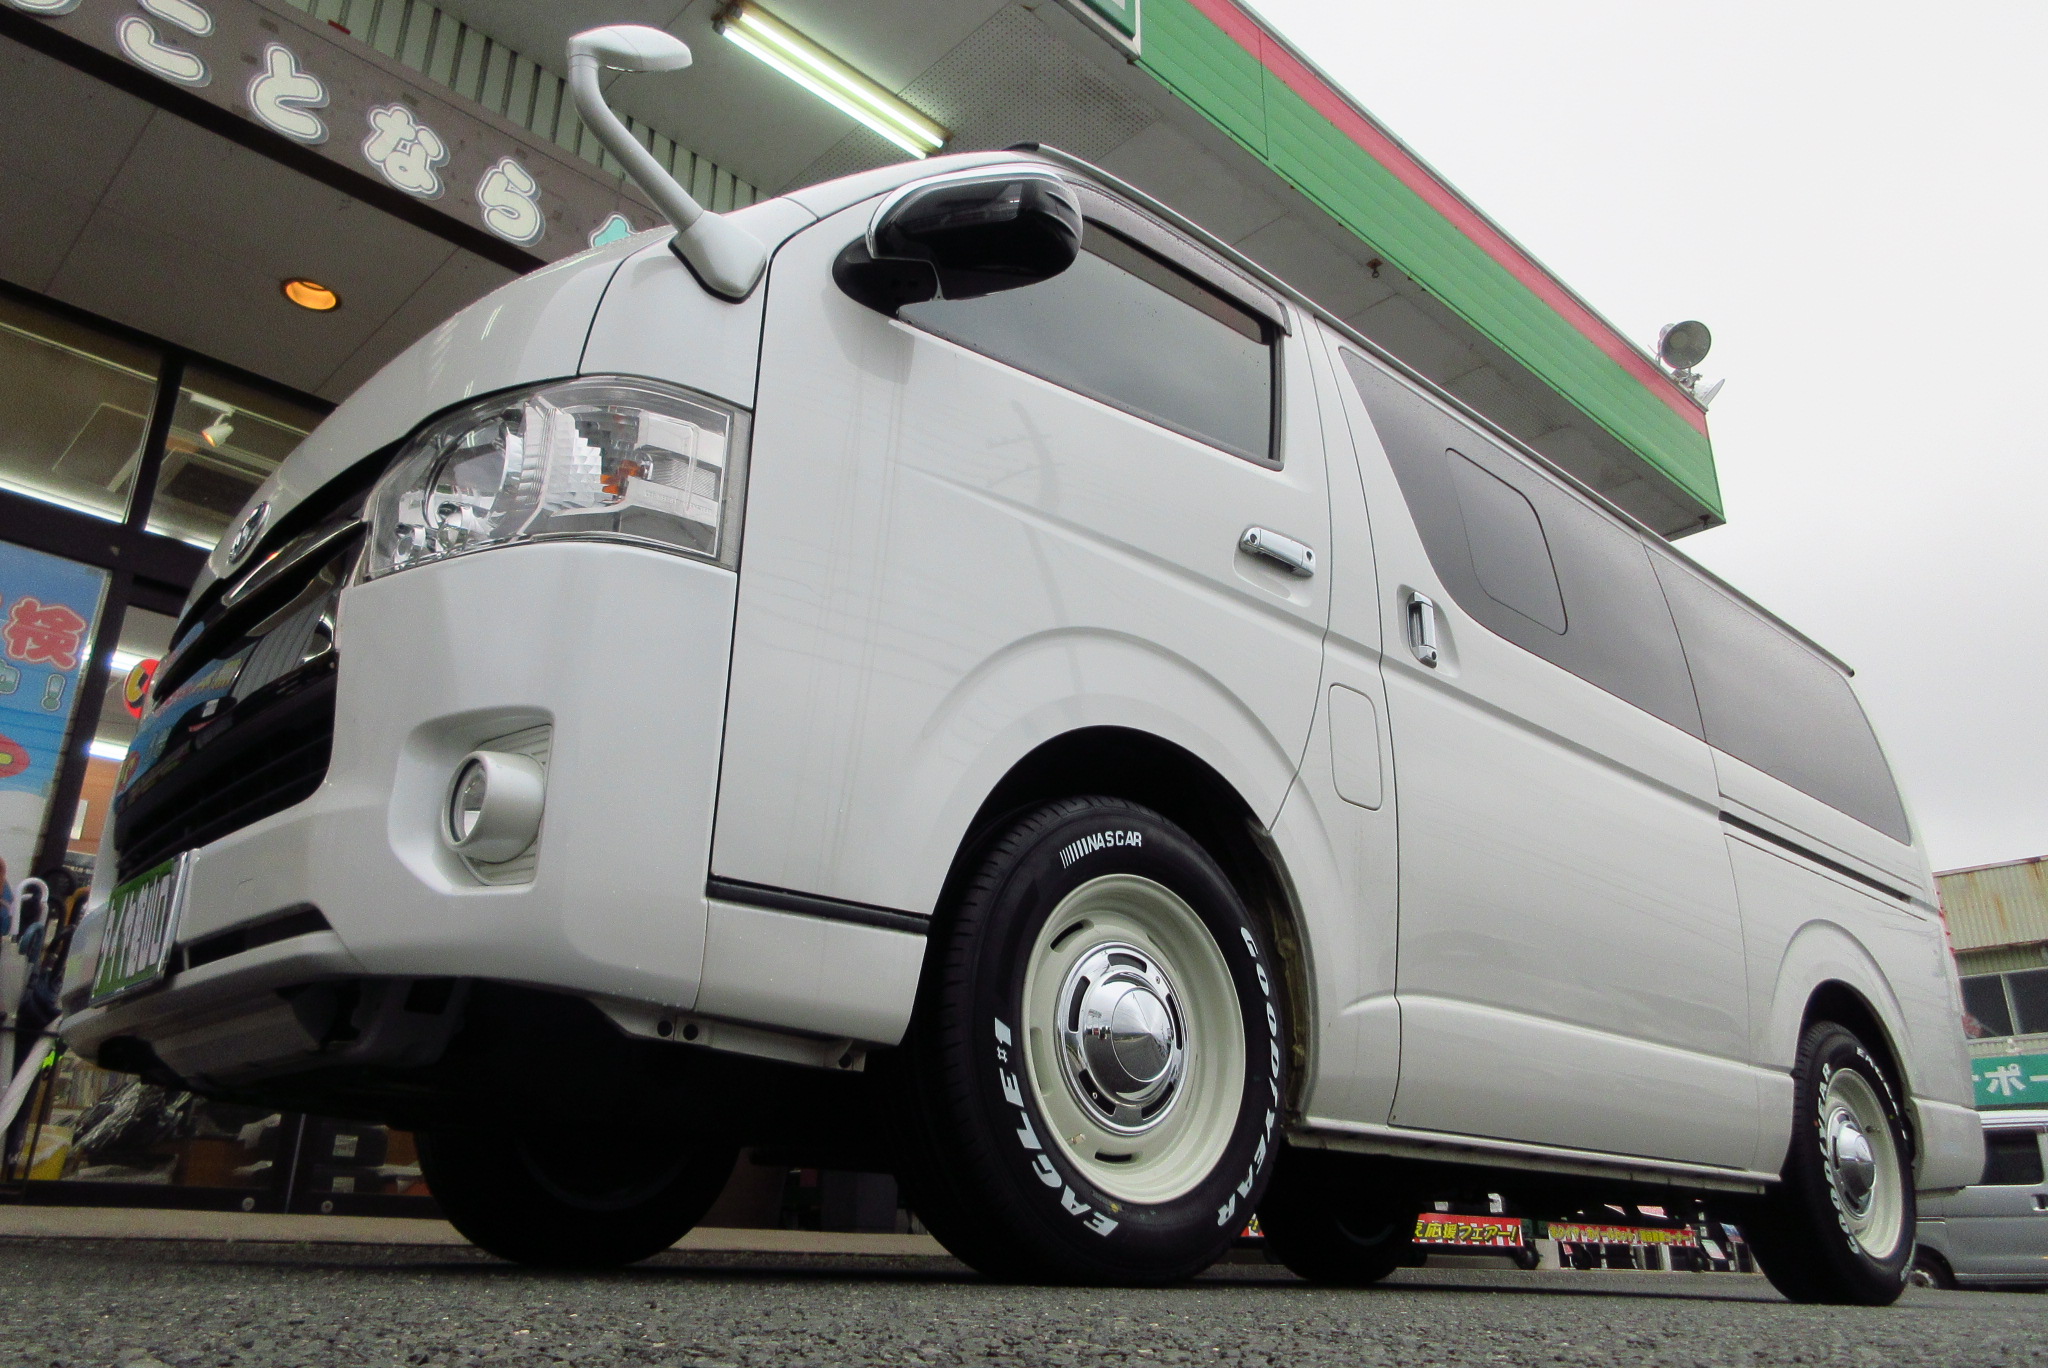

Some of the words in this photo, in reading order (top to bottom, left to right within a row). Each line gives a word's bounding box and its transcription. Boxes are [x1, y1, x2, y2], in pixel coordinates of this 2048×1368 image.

[8, 0, 546, 247] ことなら
[1086, 830, 1142, 853] NASCAR
[999, 1067, 1119, 1237] EAGLE
[1217, 927, 1280, 1227] GOODYEAR
